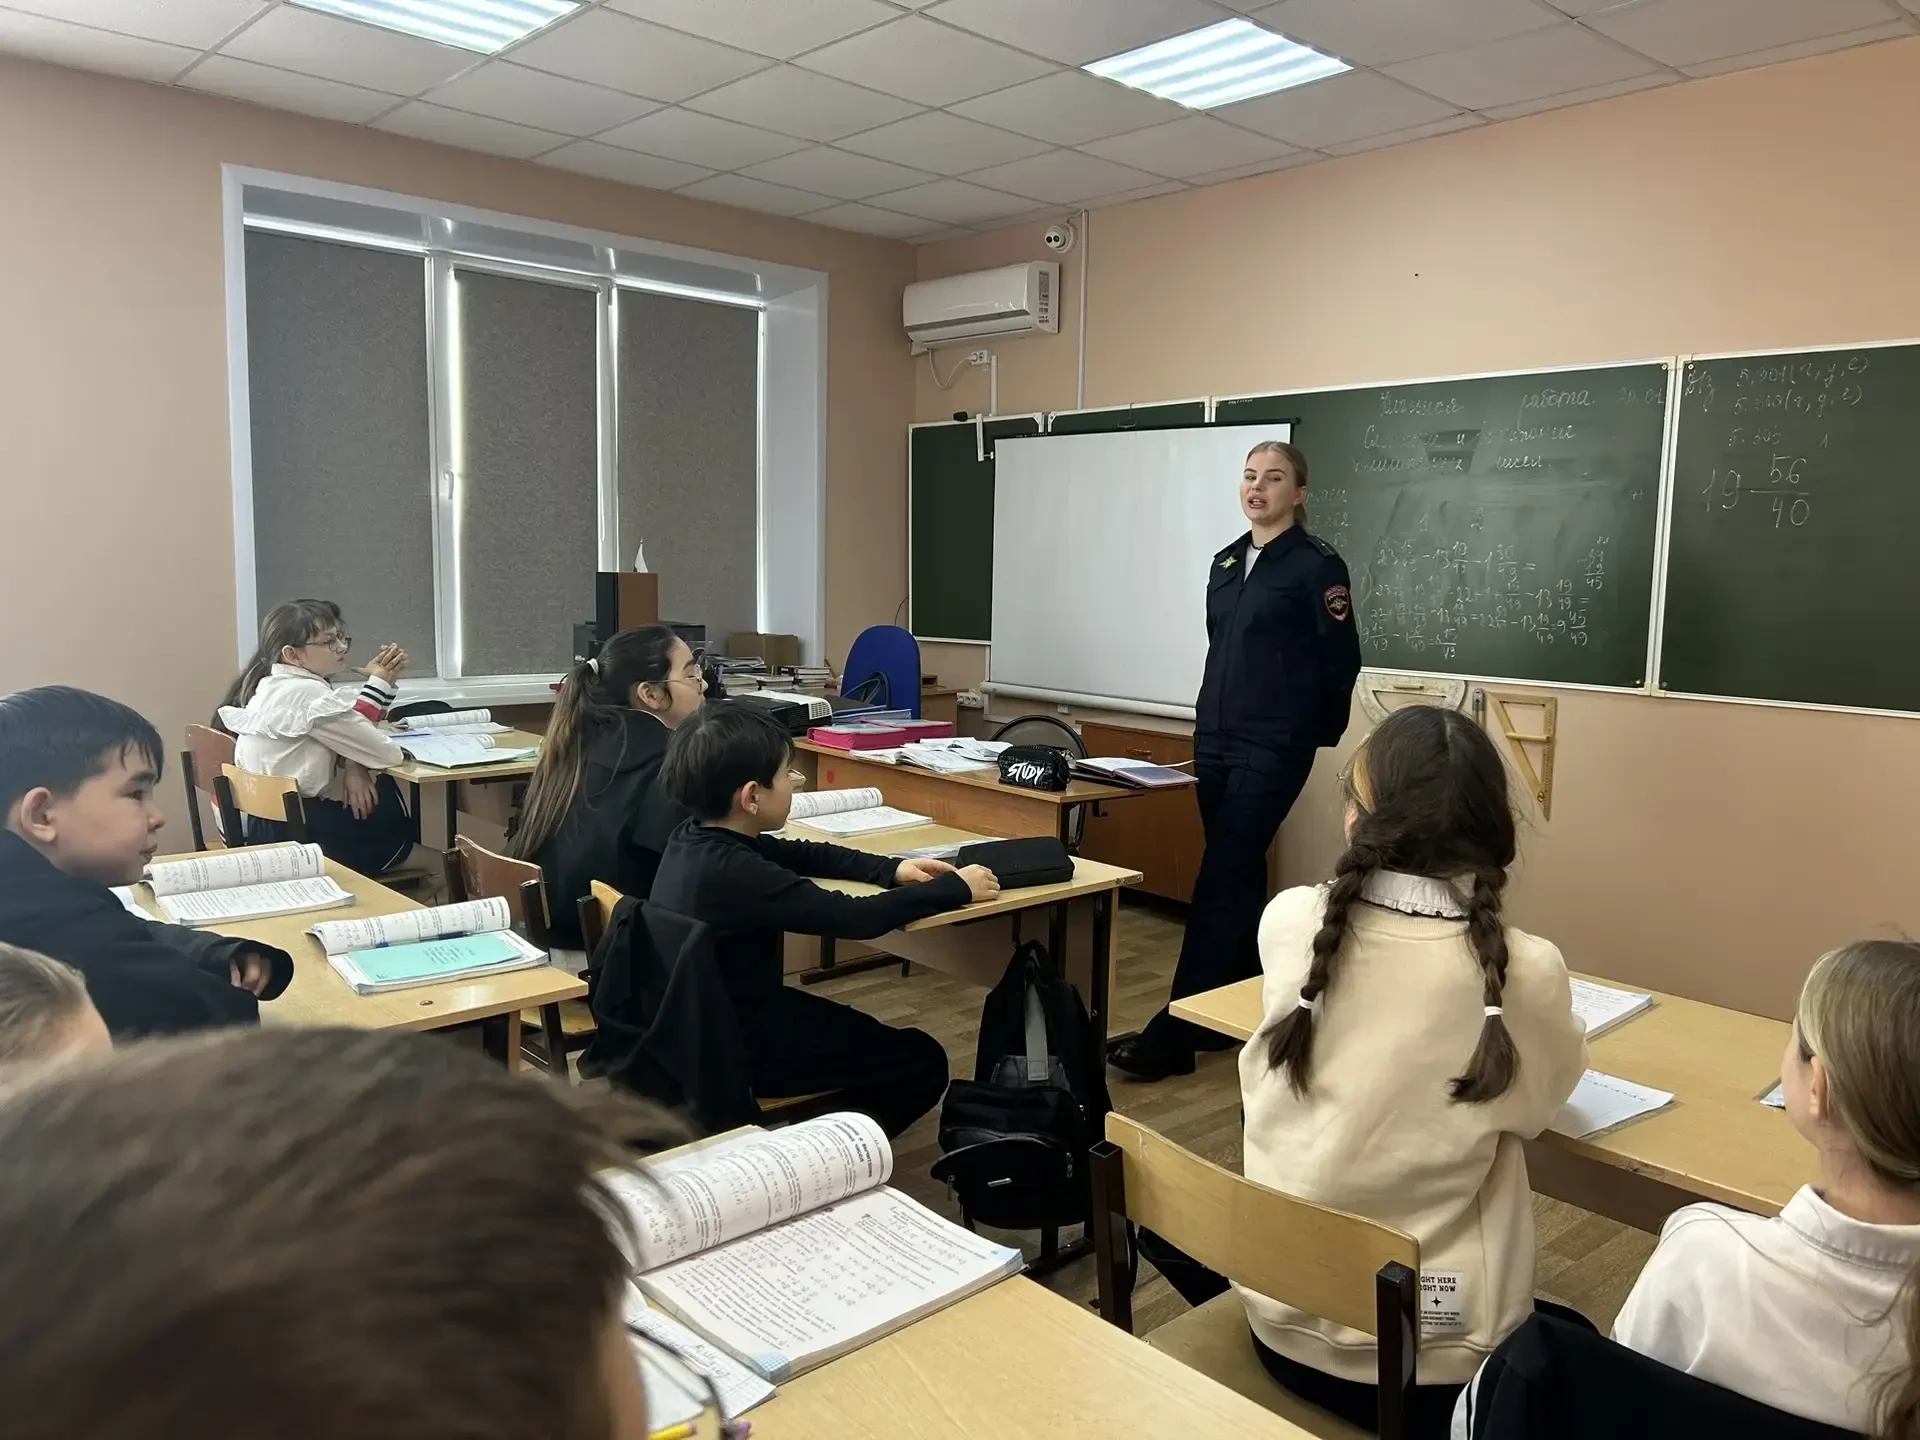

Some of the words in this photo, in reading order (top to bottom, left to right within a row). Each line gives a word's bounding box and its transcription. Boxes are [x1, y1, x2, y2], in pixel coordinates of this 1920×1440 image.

[1770, 453, 1806, 484] 56
[1702, 469, 1741, 512] 19
[1772, 497, 1810, 528] 40
[1007, 762, 1044, 785] STUDY
